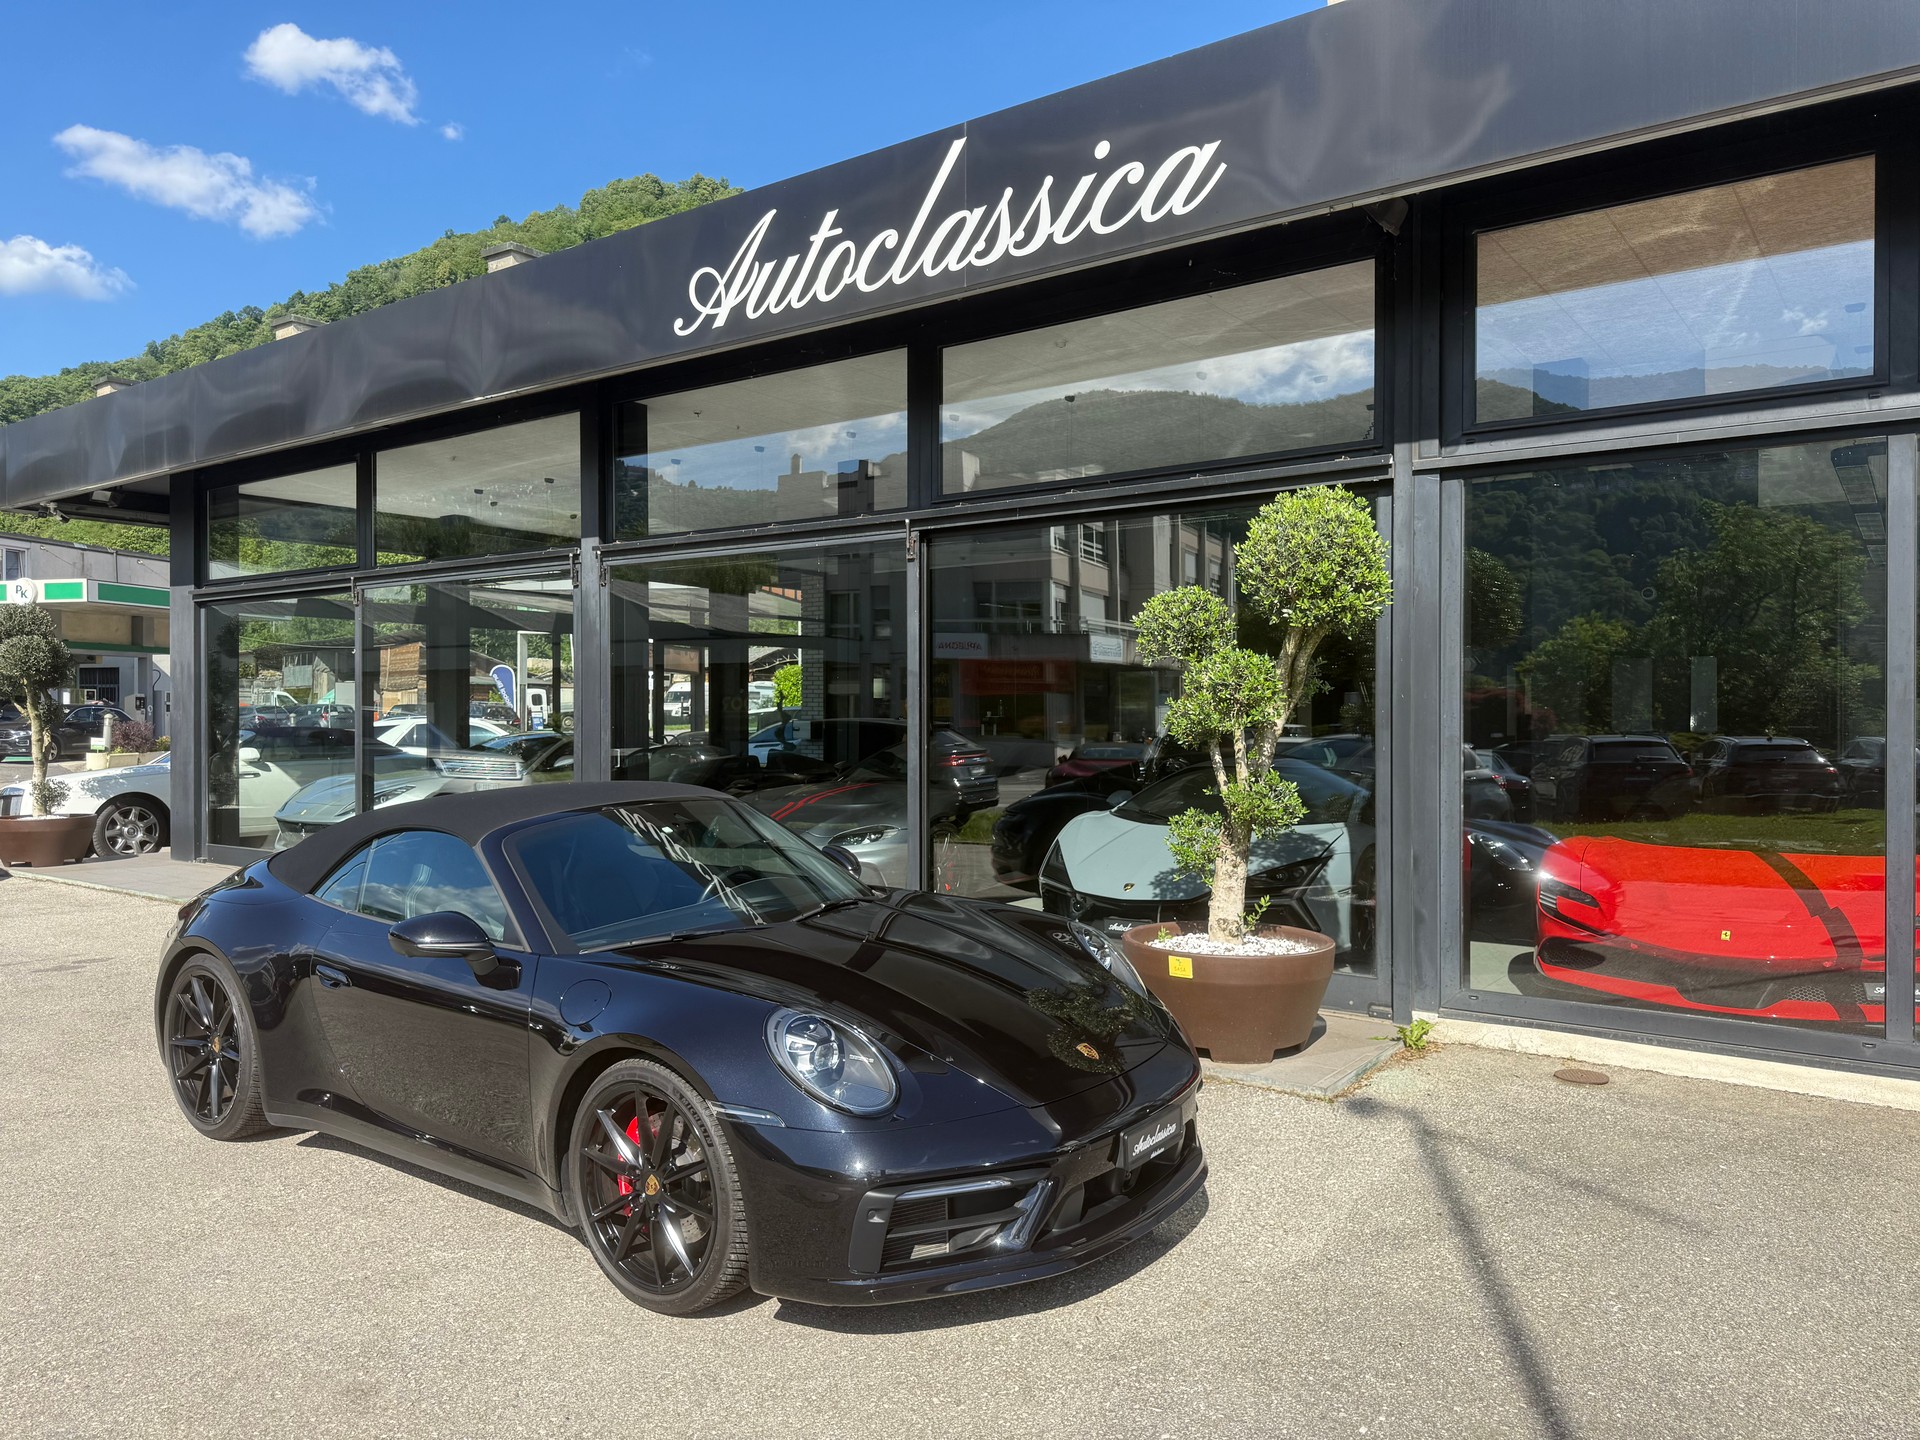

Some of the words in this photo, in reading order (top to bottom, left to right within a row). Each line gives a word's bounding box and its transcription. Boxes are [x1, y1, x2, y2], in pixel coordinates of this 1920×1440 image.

[674, 137, 1227, 336] Autoclassica
[681, 1097, 713, 1145] MICHELIN
[1132, 1123, 1177, 1156] Autoclassica
